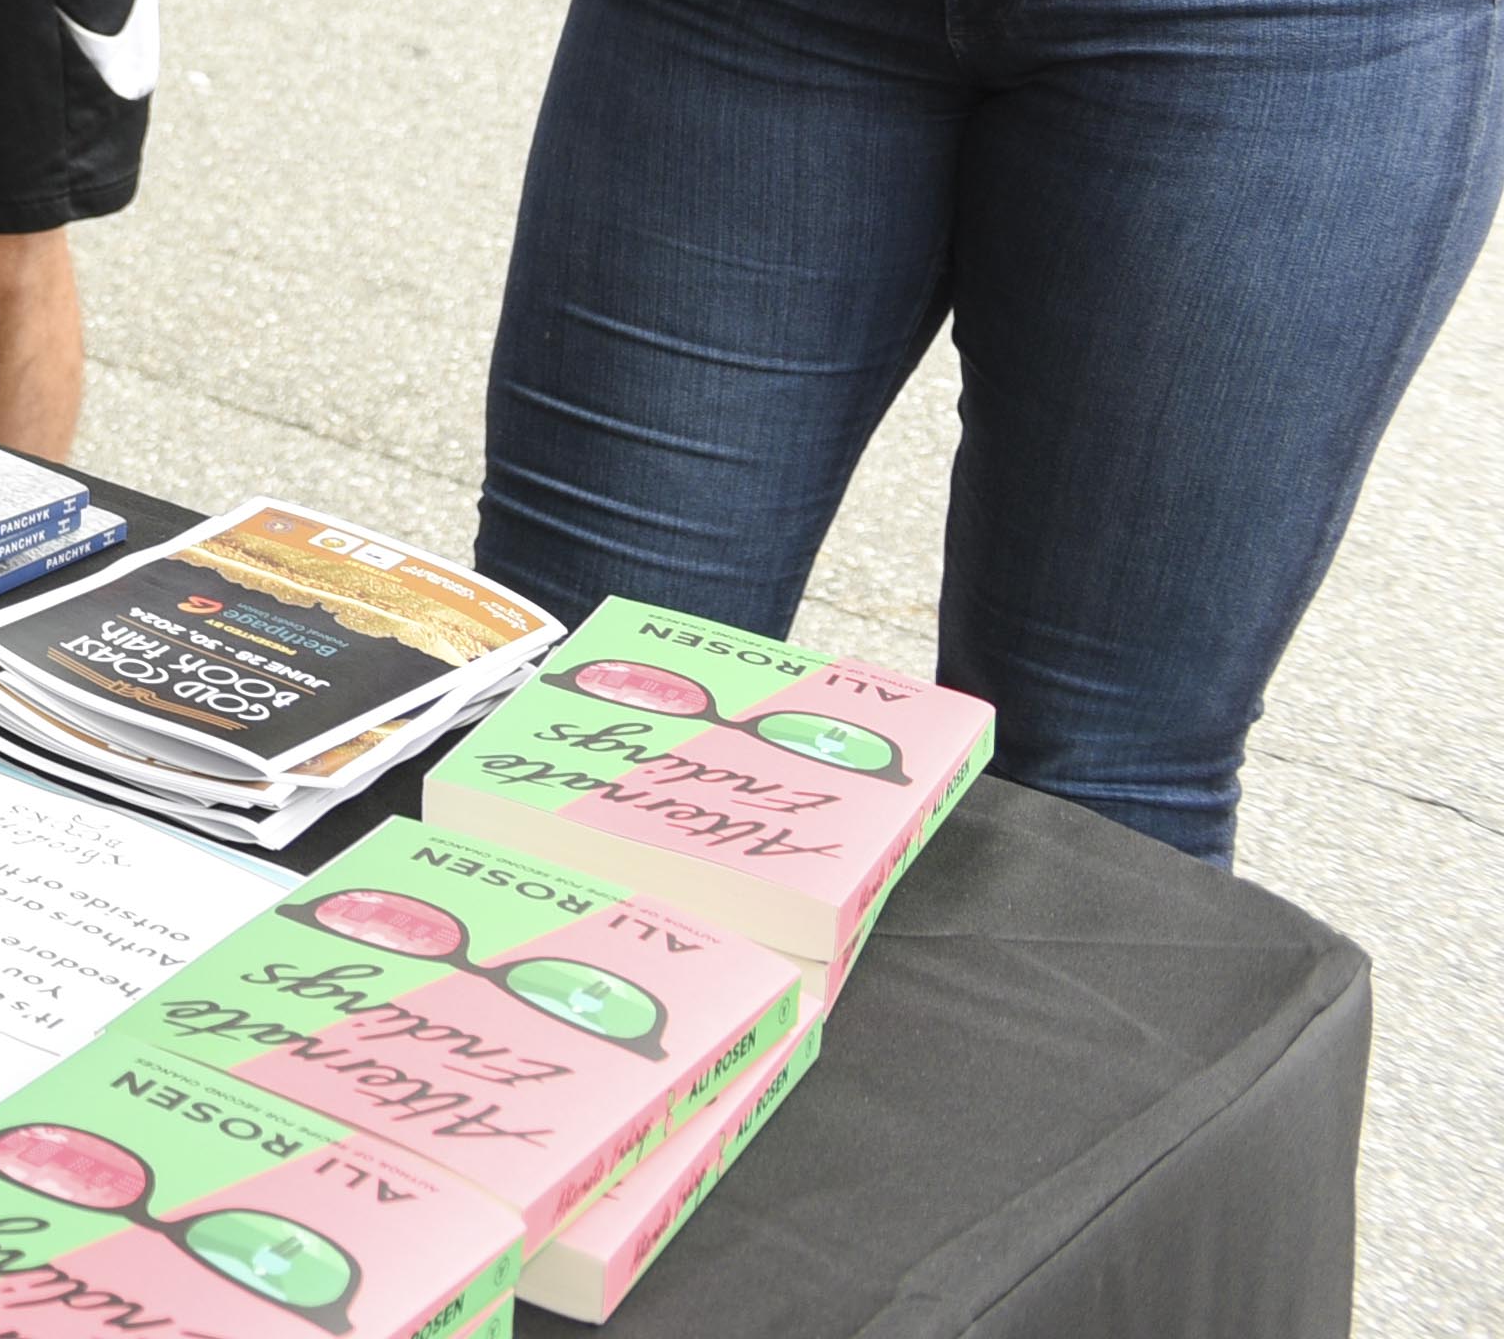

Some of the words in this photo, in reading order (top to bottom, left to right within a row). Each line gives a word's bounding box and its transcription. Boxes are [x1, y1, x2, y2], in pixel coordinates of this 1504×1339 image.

[0, 507, 51, 537] PANCHYK
[101, 620, 168, 662] FAIR
[221, 607, 341, 660] Bethpage
[638, 621, 806, 678] ROSEN
[60, 635, 170, 686] COAST
[168, 655, 302, 710] BOOK
[173, 680, 271, 723] GOLD
[824, 672, 912, 703] ALI
[532, 721, 844, 815] Endings
[474, 751, 844, 861] Alternate
[19, 866, 64, 893] of
[409, 846, 597, 916] ROSEN
[49, 909, 187, 969] Authors
[69, 889, 191, 944] outside
[609, 912, 707, 956] ALI
